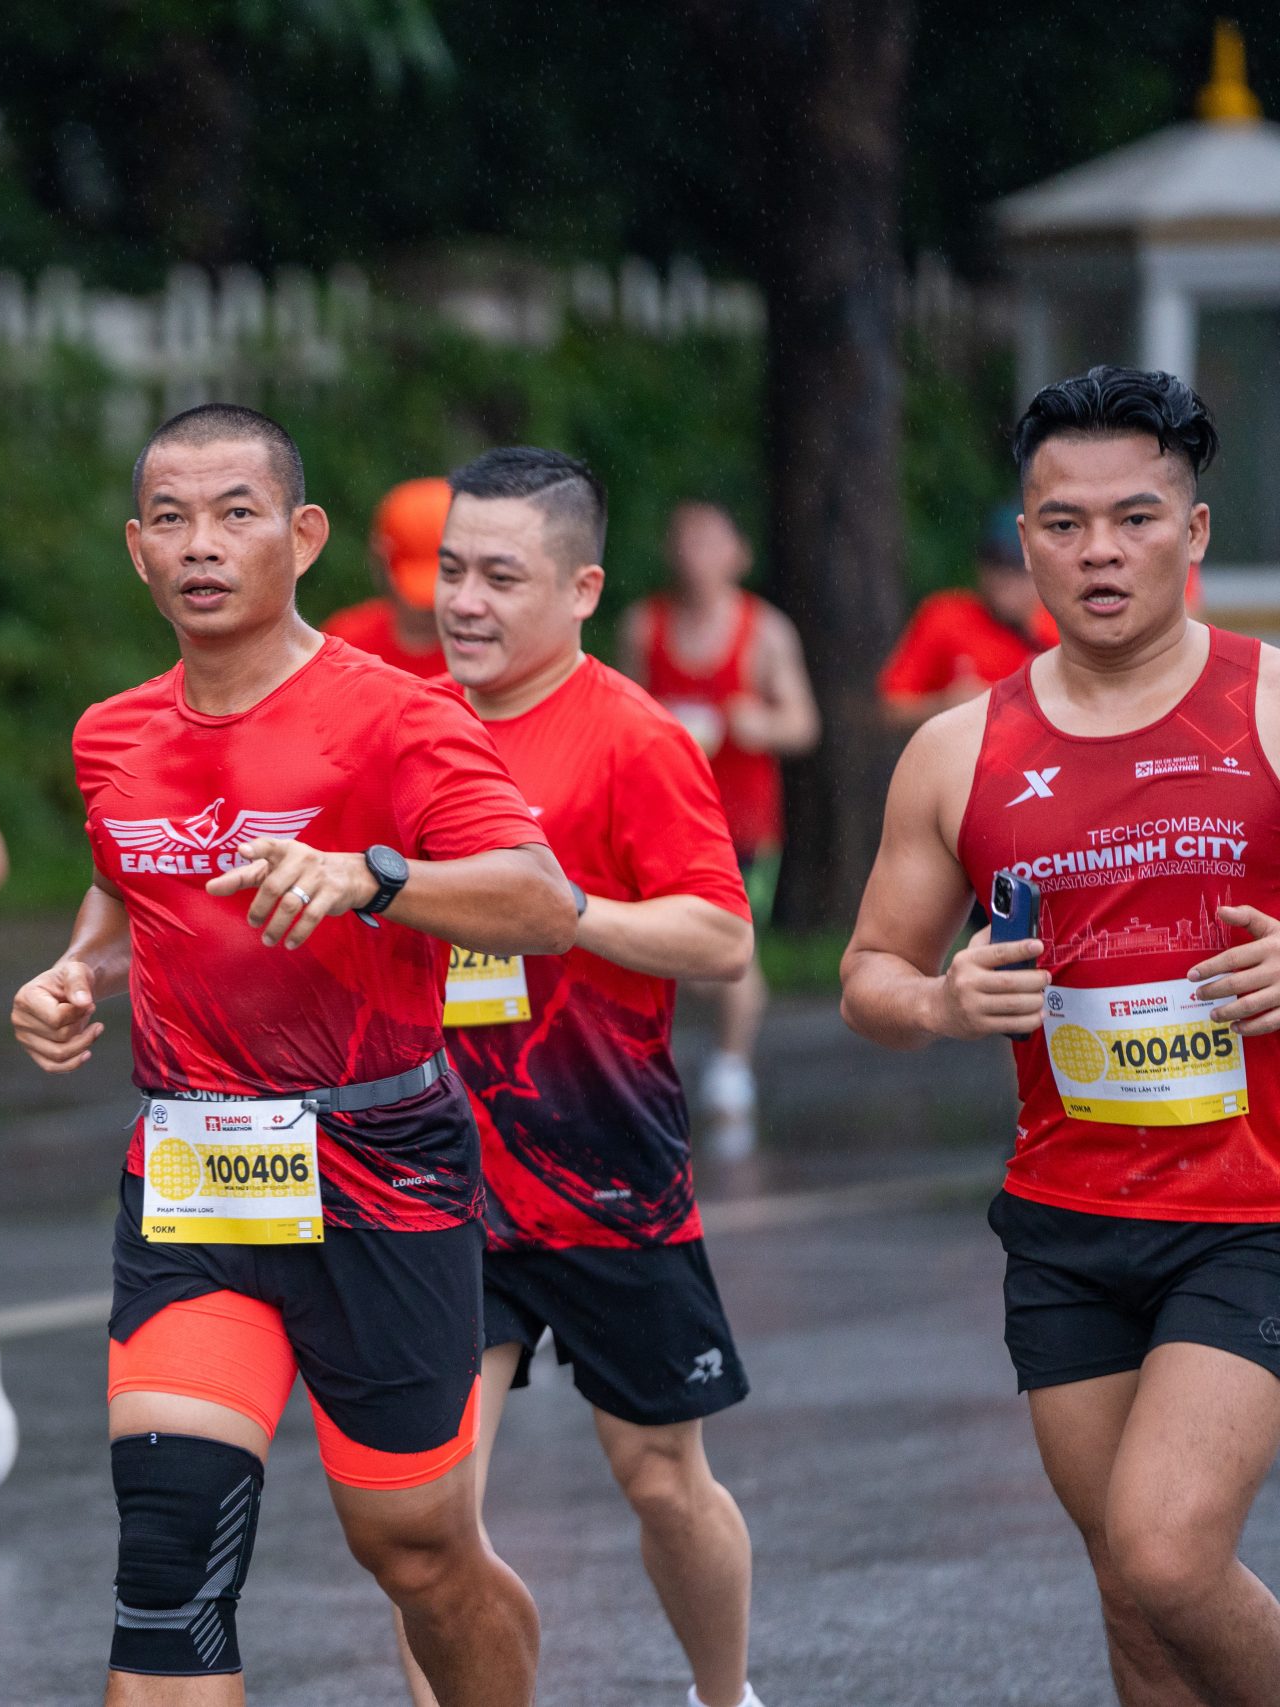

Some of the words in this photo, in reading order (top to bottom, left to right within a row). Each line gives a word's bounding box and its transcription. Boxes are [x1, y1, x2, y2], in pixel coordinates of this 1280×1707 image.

[1154, 764, 1200, 775] MARATHON
[1211, 766, 1251, 776] TECHCOMBANK
[1087, 816, 1245, 846] TECHCOMBANK
[120, 853, 213, 875] EAGLE
[994, 838, 1167, 881] OCHIMINH
[1175, 835, 1249, 861] CITY
[1138, 859, 1246, 879] MARATHON
[1131, 996, 1167, 1009] HANOI
[1132, 1006, 1169, 1016] MARATHON
[1111, 1028, 1233, 1068] 100405
[1071, 1104, 1092, 1113] 10KM
[221, 1115, 252, 1124] HANOI
[205, 1153, 309, 1184] 100406
[392, 1173, 437, 1188] LONG.VN
[150, 1433, 158, 1444] 2
